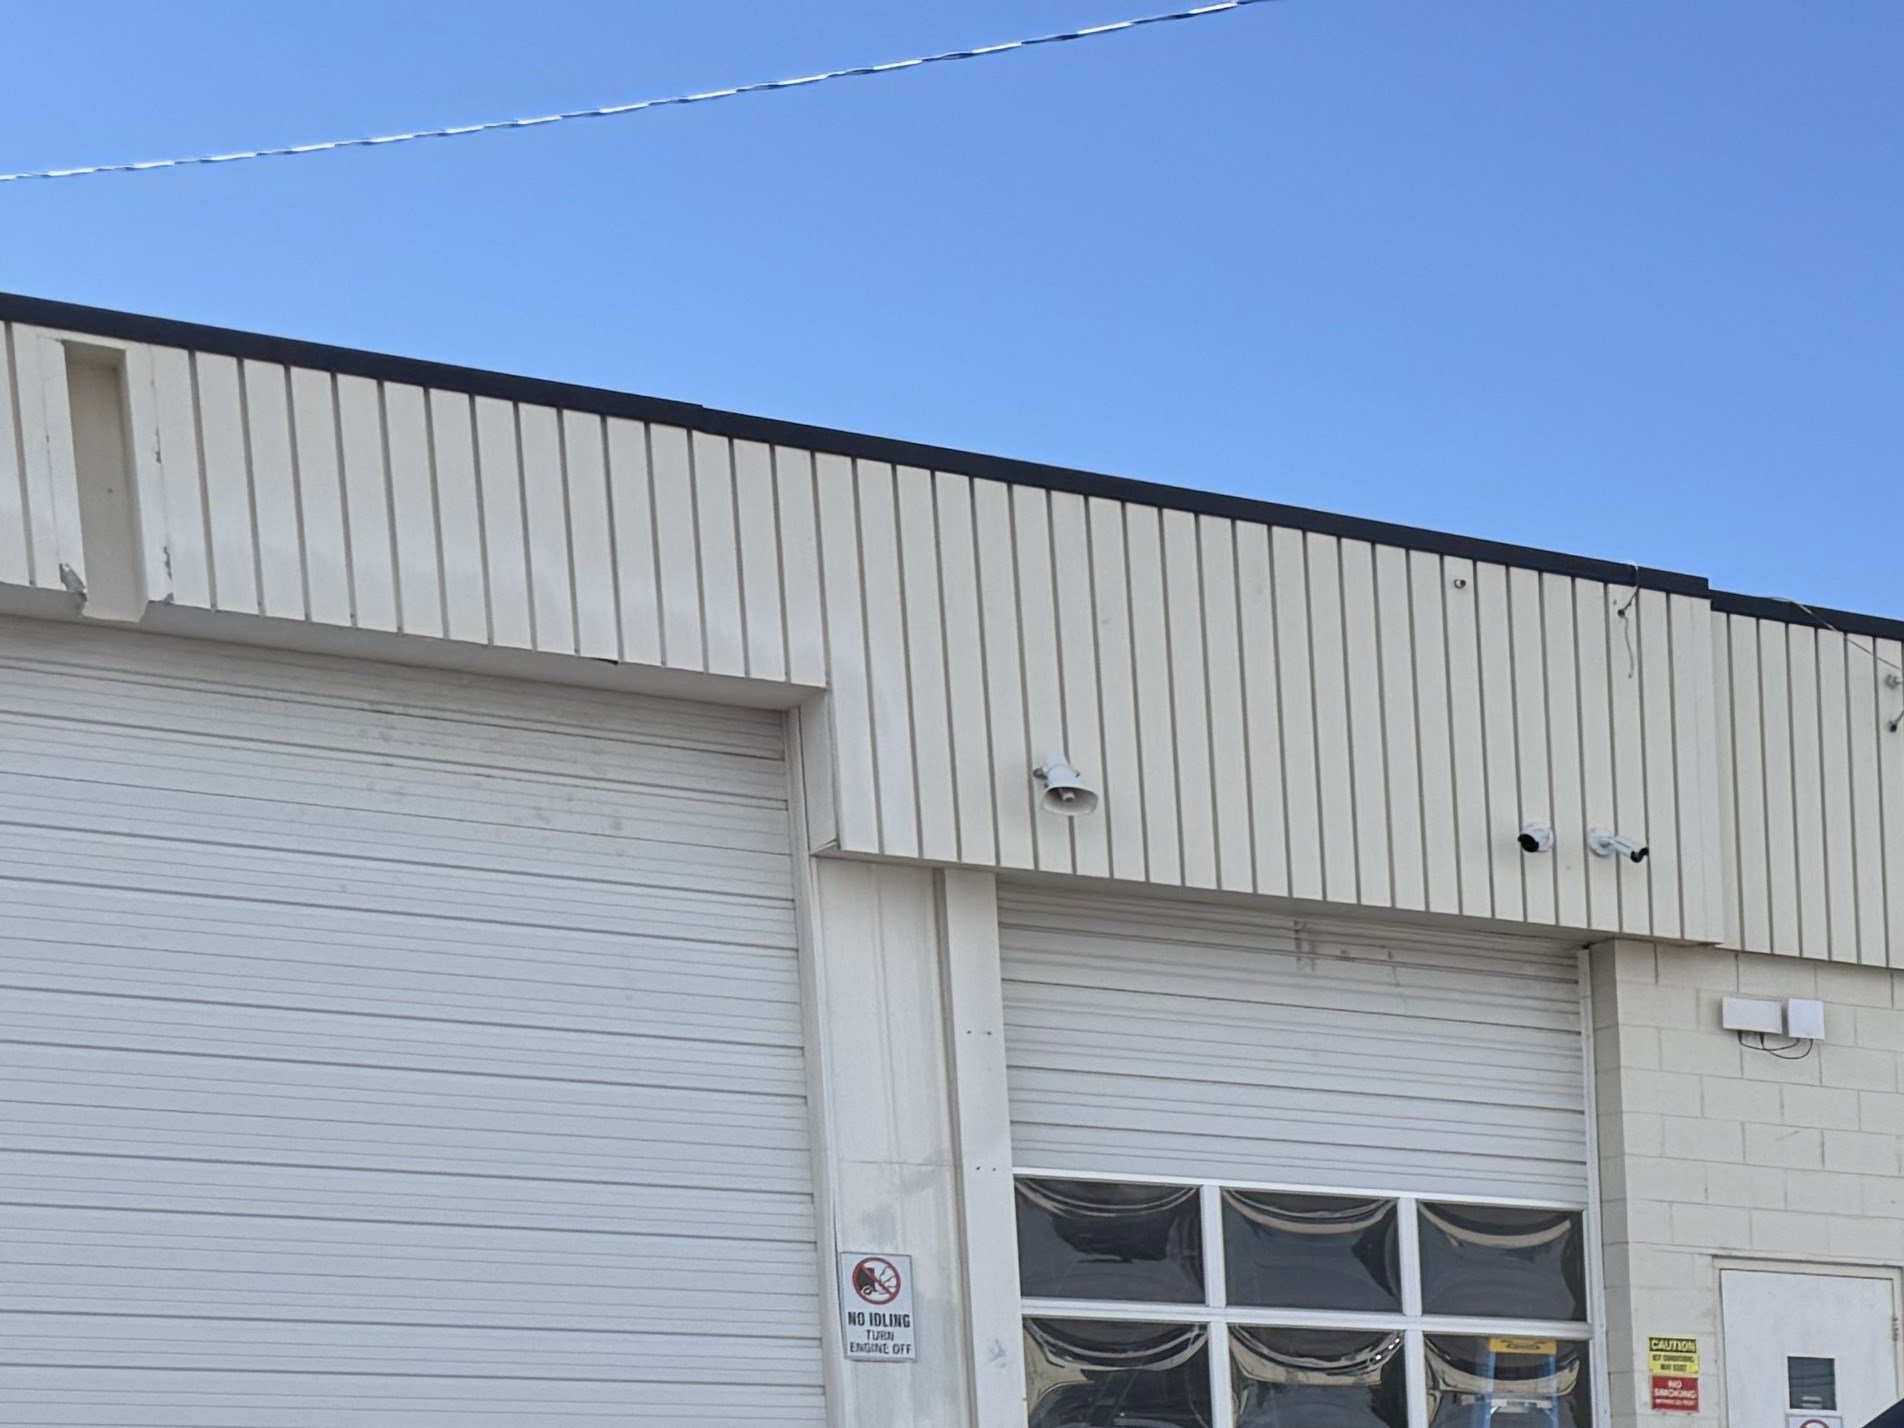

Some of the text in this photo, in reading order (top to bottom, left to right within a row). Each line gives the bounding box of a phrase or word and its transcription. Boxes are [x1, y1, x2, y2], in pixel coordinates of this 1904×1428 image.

[847, 1311, 911, 1328] NO IDLING
[865, 1329, 895, 1342] TURN
[849, 1342, 912, 1355] ENGINE OFF
[1651, 1339, 1696, 1352] CAUTION
